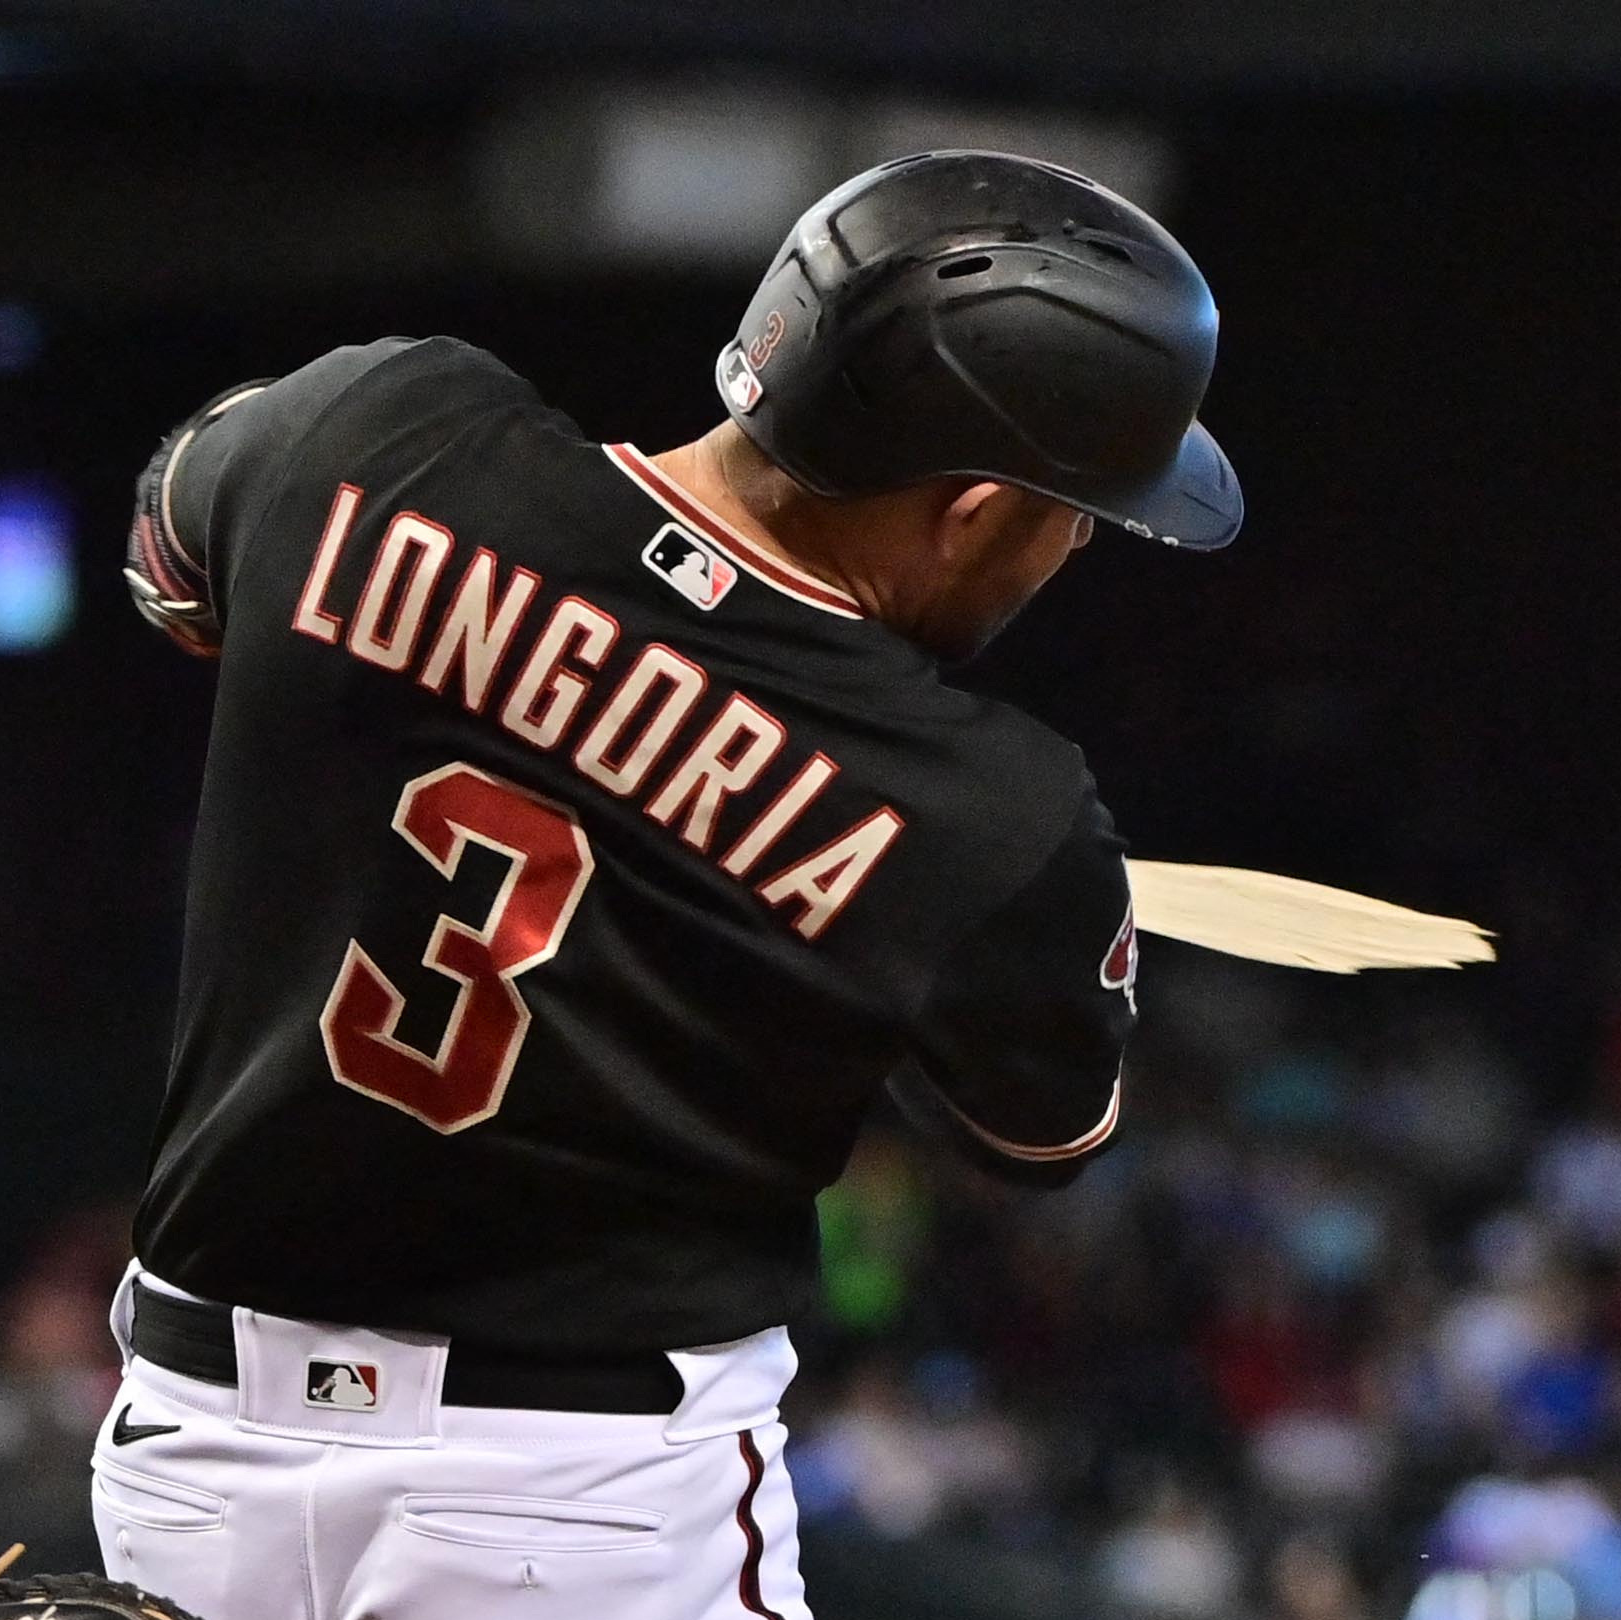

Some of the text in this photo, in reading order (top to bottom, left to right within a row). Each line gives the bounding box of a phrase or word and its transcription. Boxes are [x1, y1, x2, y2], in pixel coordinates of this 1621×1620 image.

[748, 310, 785, 371] 3
[291, 482, 906, 943] LONGORIA
[319, 760, 596, 1136] 3
